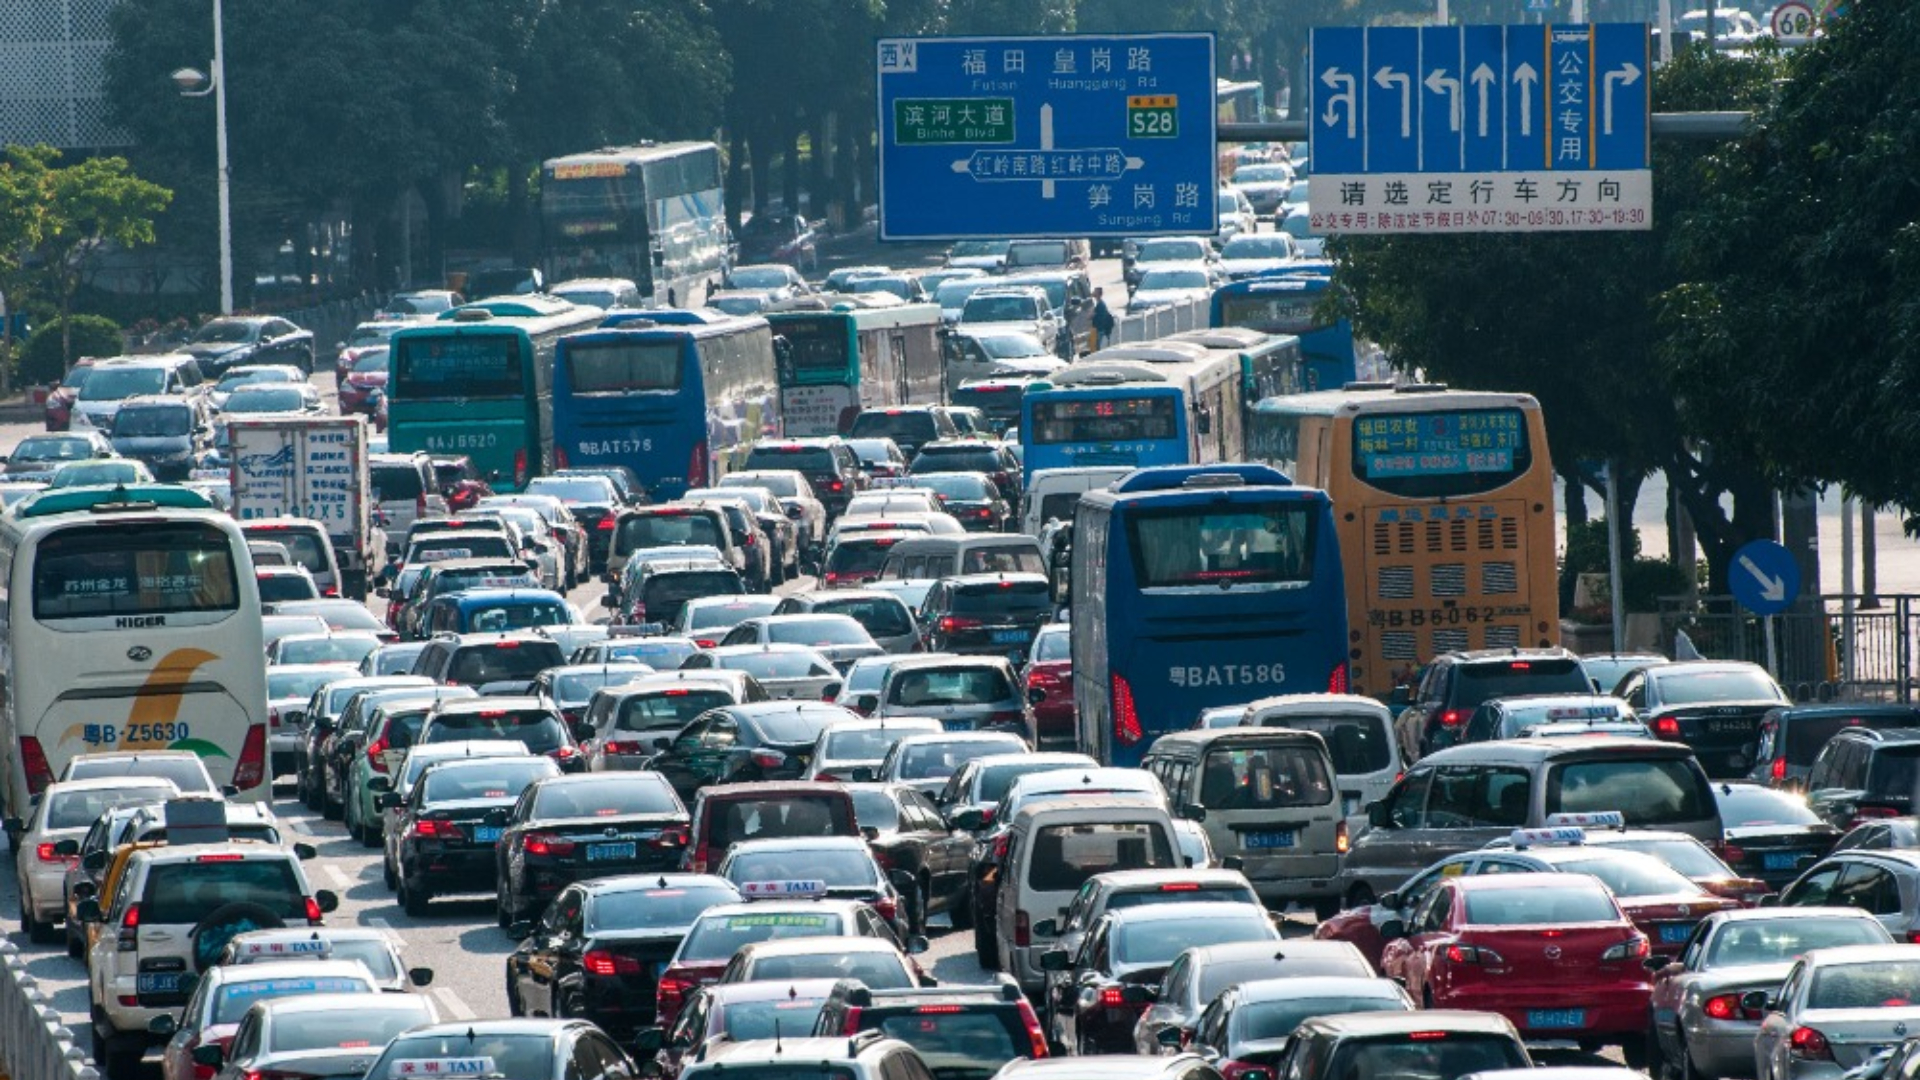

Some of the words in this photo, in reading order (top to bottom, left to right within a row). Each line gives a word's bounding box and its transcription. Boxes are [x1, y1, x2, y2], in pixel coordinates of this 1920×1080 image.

[1781, 13, 1807, 34] 60
[881, 44, 897, 67] 西
[962, 48, 1025, 75] 福田
[1053, 46, 1152, 74] 皇岗路
[972, 79, 1018, 90] Futian
[1049, 78, 1126, 91] Huanggang
[1138, 76, 1157, 88] Rd
[904, 105, 1005, 126] 滨河大道
[1558, 51, 1583, 161] 公交专用
[917, 127, 955, 139] Binhe
[965, 127, 996, 139] Blvd
[1134, 112, 1172, 133] S28
[975, 155, 1046, 176] 红岭南路
[1051, 154, 1121, 175] 红岭中路
[1088, 182, 1199, 209] 笋岗路
[1340, 179, 1620, 206] 请选定行车方向
[1099, 214, 1162, 227] Sungang
[1173, 212, 1191, 224] Rd
[116, 616, 166, 628] HIGER
[1169, 663, 1286, 687] 粤BAT586
[785, 881, 816, 892] TAXI
[290, 940, 324, 952] TAXI
[447, 1060, 485, 1073] TAXI
